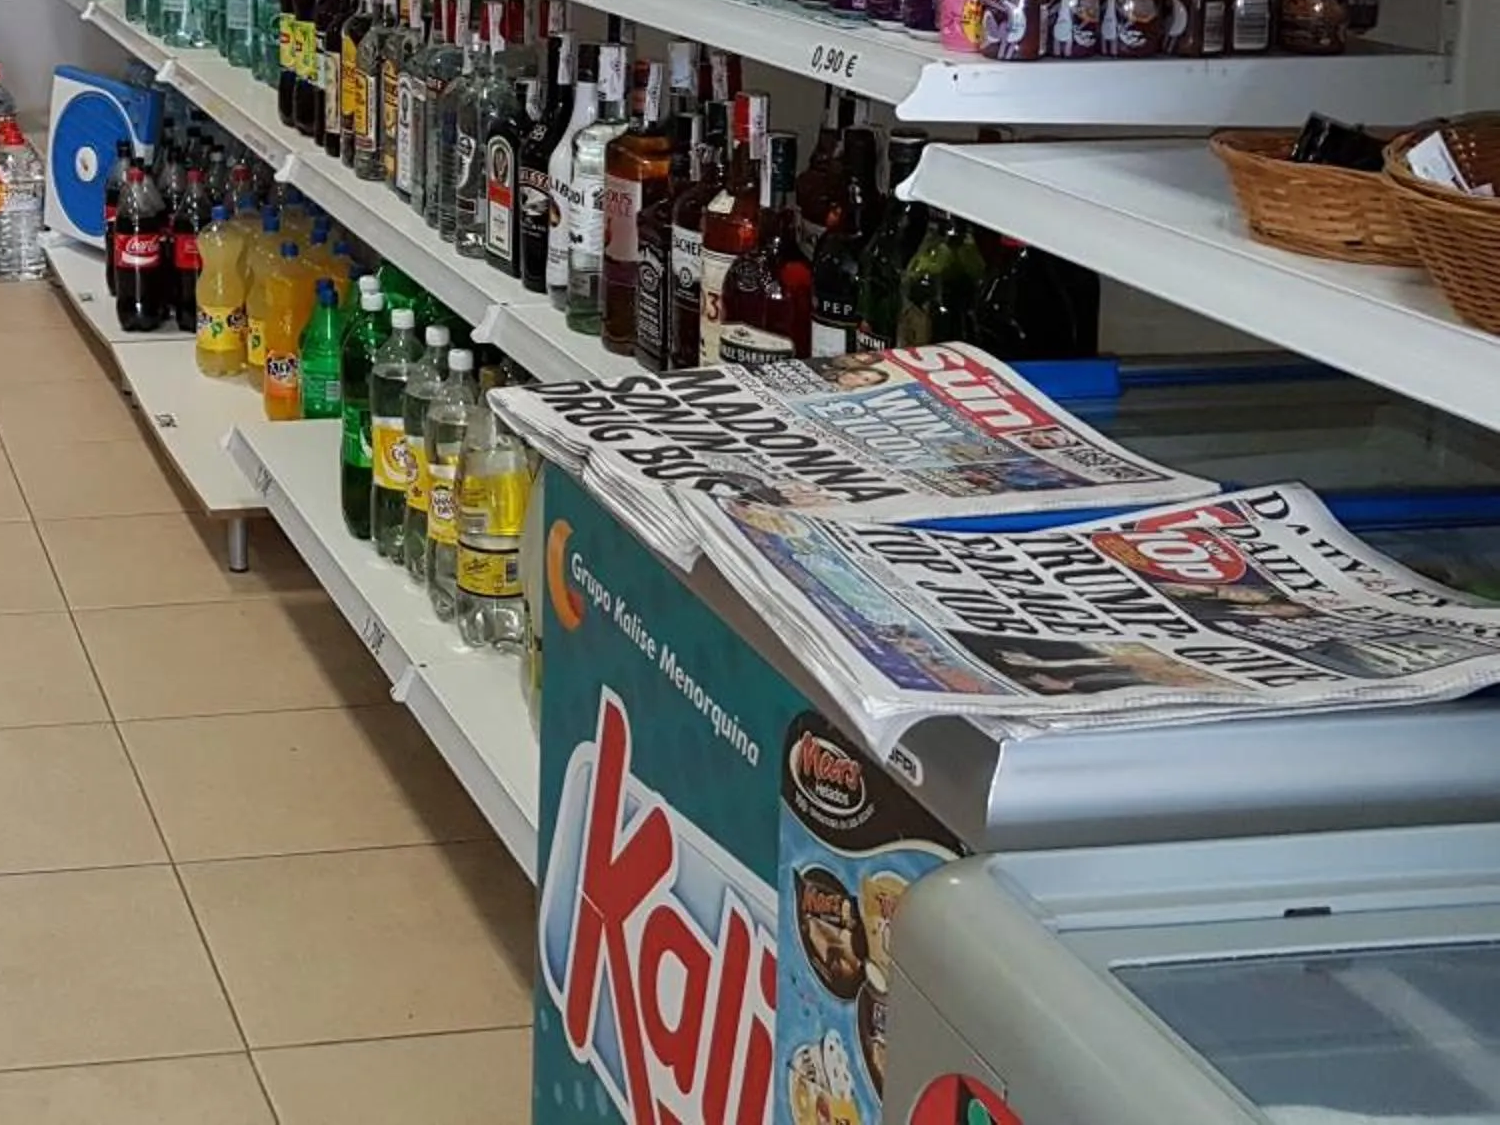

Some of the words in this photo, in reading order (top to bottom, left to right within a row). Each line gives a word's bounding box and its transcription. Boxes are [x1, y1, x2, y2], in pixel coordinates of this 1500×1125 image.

[811, 44, 844, 74] 0,90
[846, 53, 858, 79] €
[524, 379, 663, 443] DRUG
[588, 375, 700, 426] SON
[663, 427, 754, 454] IN
[658, 367, 909, 503] MADONNA
[863, 388, 964, 439] WIN
[857, 528, 962, 575] TOP
[916, 579, 1040, 636] JOB
[571, 551, 613, 619] Grupo
[612, 587, 657, 662] Kalise
[658, 644, 760, 768] Menorquina
